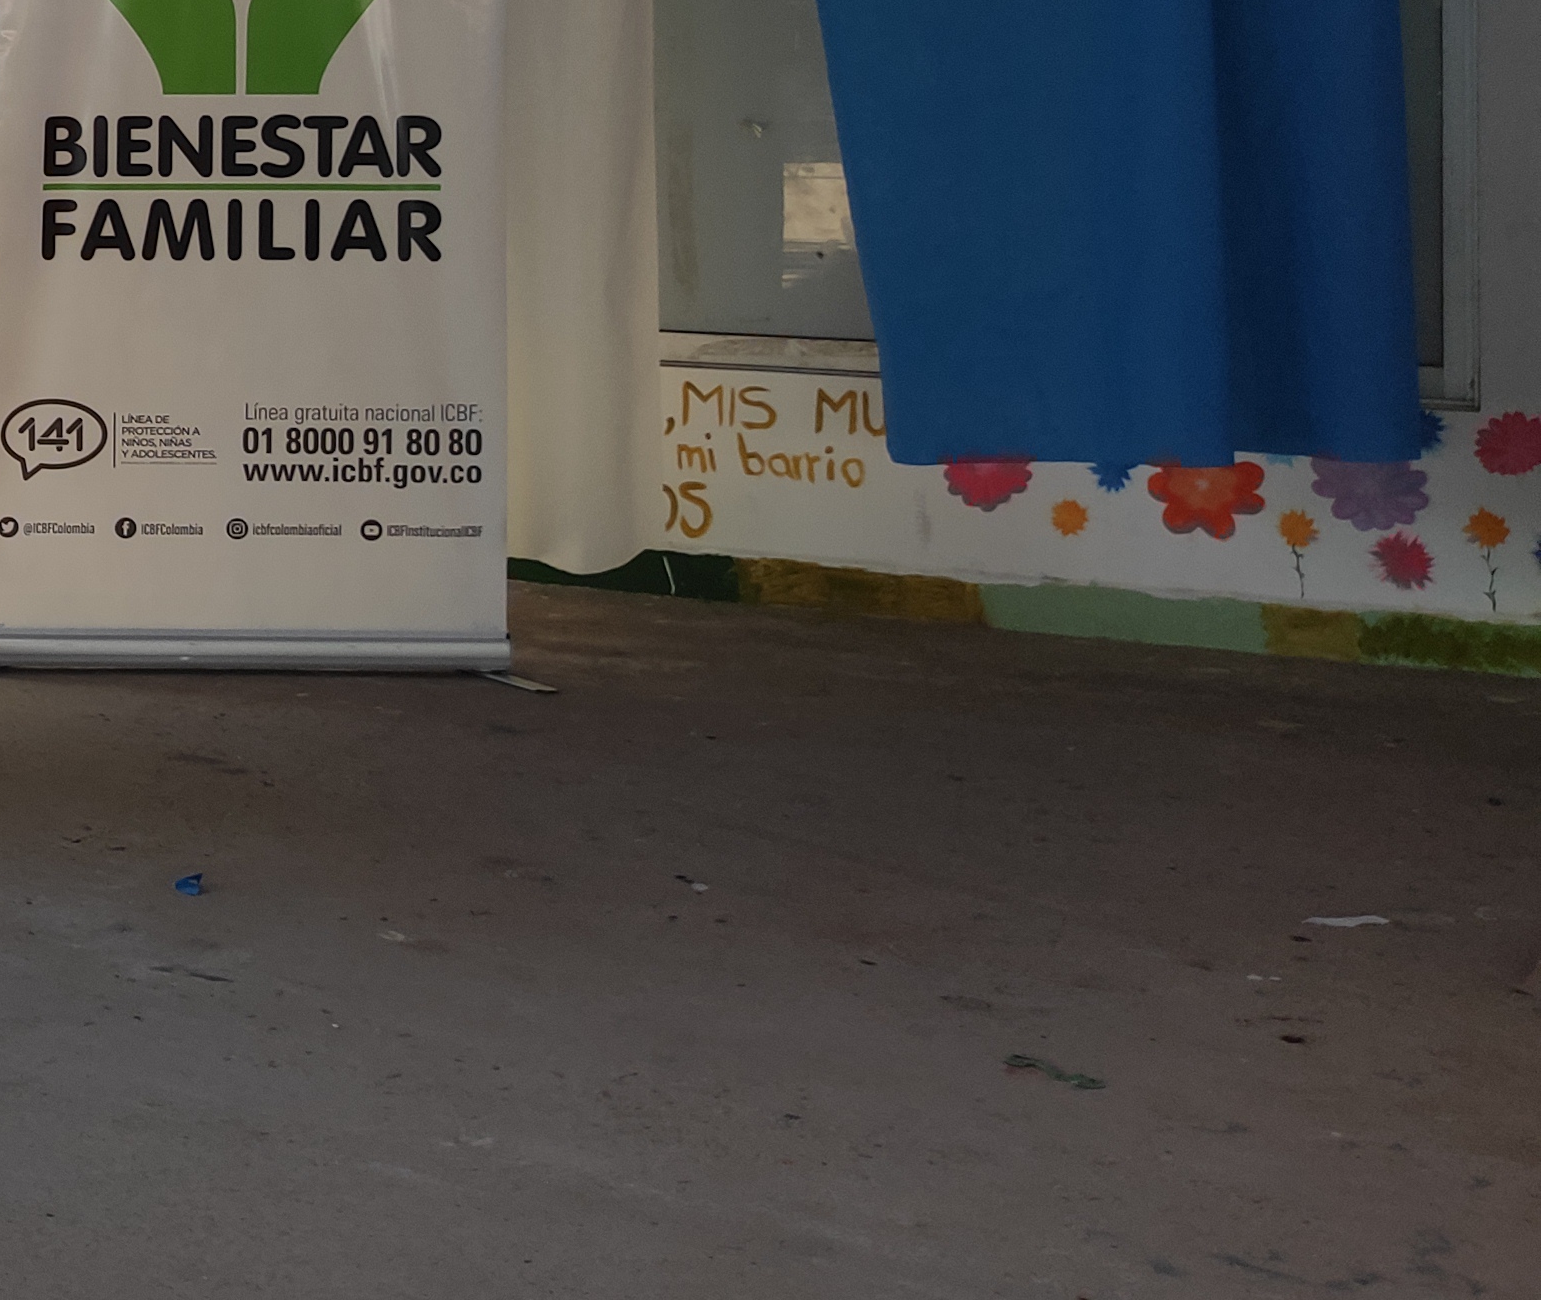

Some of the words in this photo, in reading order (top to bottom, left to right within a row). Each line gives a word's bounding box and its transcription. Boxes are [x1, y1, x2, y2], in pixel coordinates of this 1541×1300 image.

[43, 114, 442, 178] BIENESTAR
[41, 198, 442, 262] FAMILIAR
[121, 413, 148, 424] LÍNEA
[155, 415, 170, 424] DE
[245, 402, 288, 422] Línea
[294, 402, 359, 425] gratuita
[365, 404, 435, 422] nacional
[441, 403, 484, 423] ICBF:
[18, 417, 83, 452] 141
[121, 425, 190, 436] PROTECCIÓN
[192, 427, 201, 436] A
[159, 436, 192, 447] NIÑAS
[242, 427, 272, 454] 01
[285, 427, 355, 454] 8000
[363, 427, 393, 455] 91
[406, 428, 440, 456] 80
[448, 428, 483, 456] 80
[121, 449, 129, 458] Y
[677, 432, 716, 473] mi
[737, 432, 865, 488] barrio
[243, 457, 483, 489] www.icbf.gov.co
[23, 521, 95, 536] @ICBFColombia
[140, 522, 204, 537] ICBFColombia
